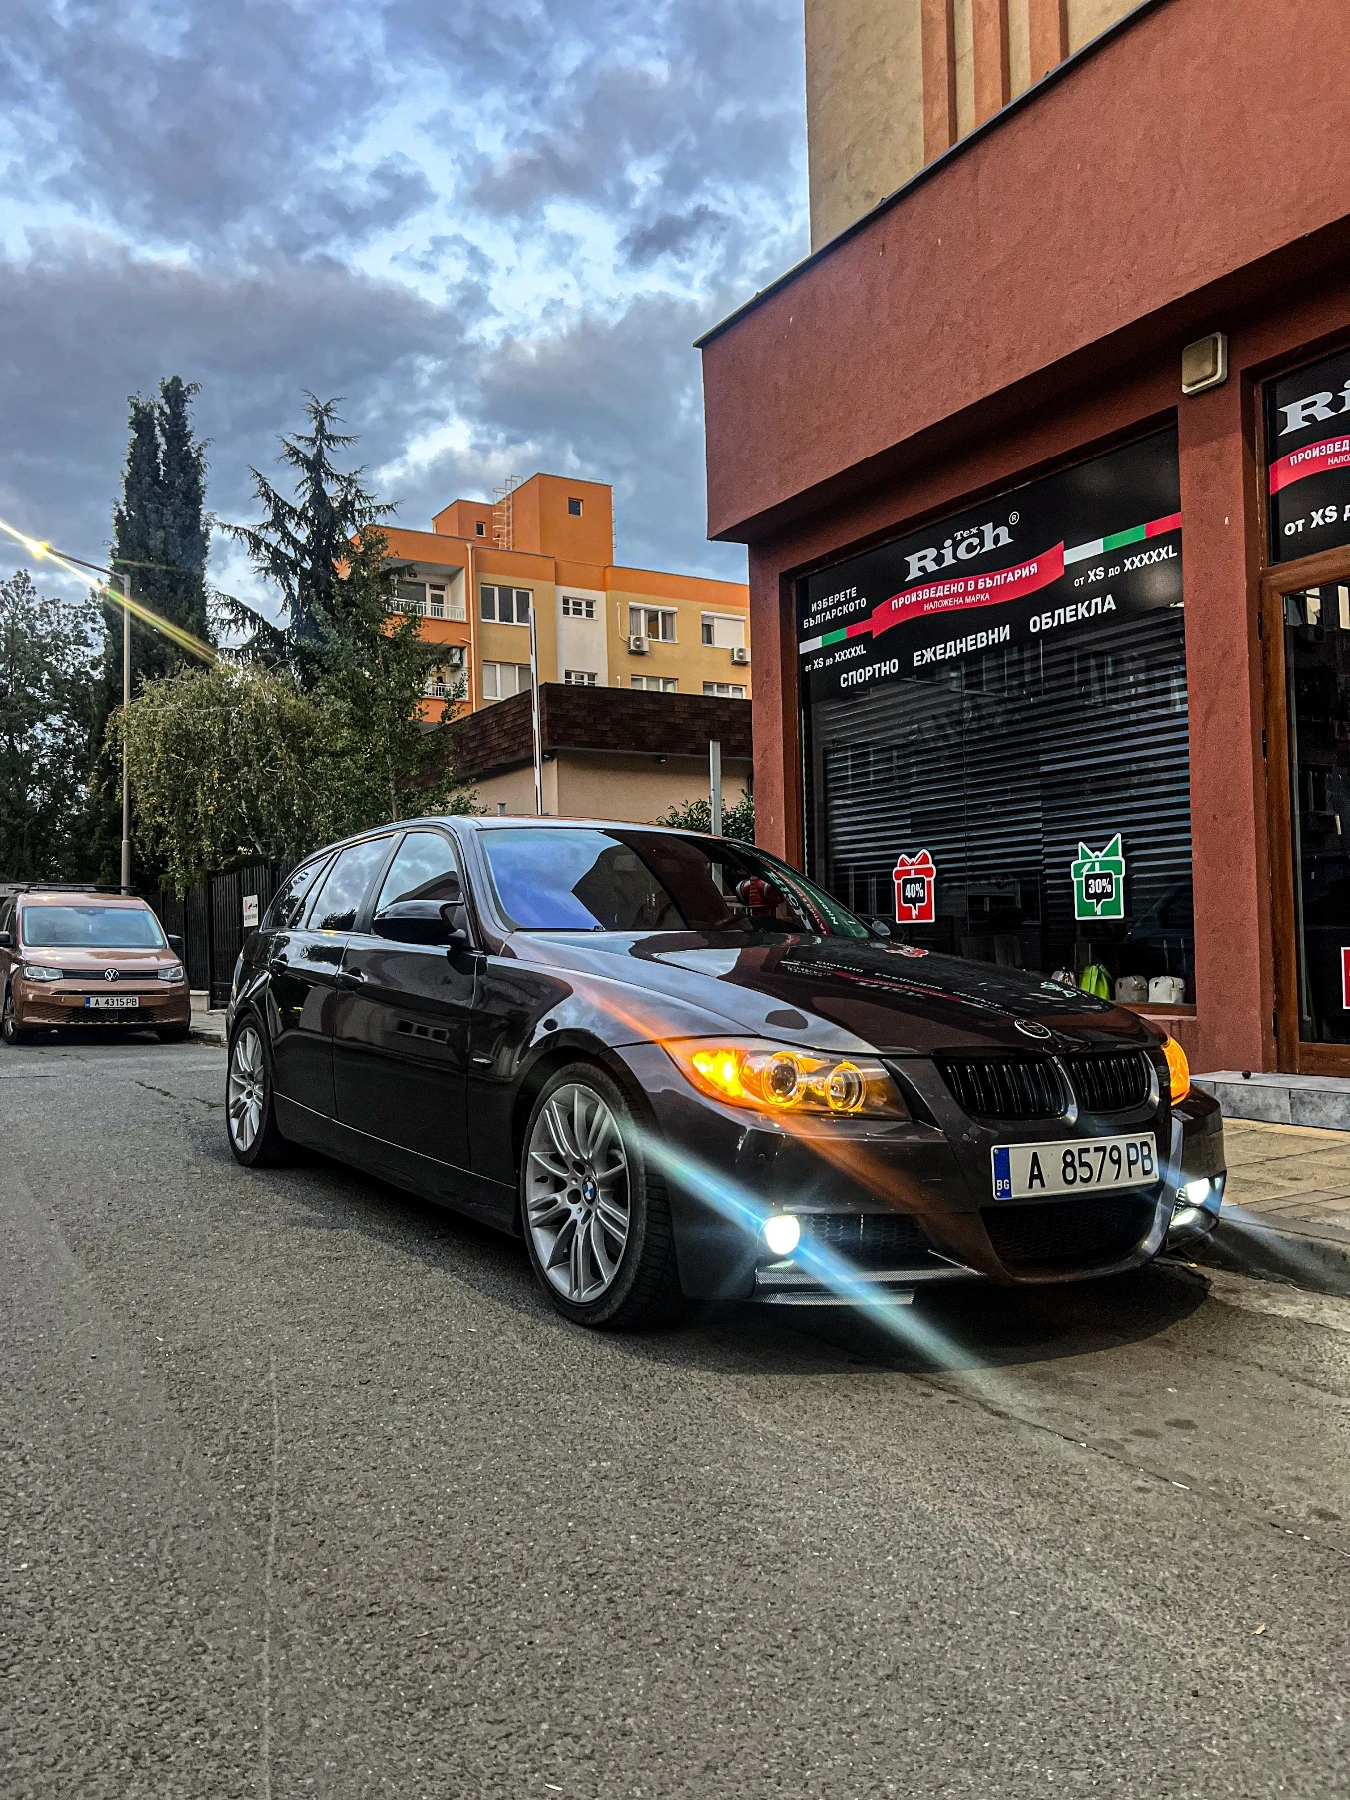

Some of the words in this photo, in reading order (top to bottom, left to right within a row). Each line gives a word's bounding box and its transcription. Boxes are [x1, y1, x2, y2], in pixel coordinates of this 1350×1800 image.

[1327, 453, 1350, 466] НАЛО
[1284, 519, 1305, 535] от
[1310, 505, 1337, 528] XS
[954, 526, 978, 541] Tex
[904, 522, 1014, 581] Rich
[891, 581, 964, 610] ПРОИЗВЕДЕНО
[978, 562, 1038, 587] БЪЛГАРИЯ
[1074, 577, 1084, 587] от
[1087, 567, 1105, 583] XS
[1108, 566, 1120, 577] до
[811, 587, 857, 613] ИЗБЕРЕТЕ
[923, 596, 964, 611] НАЛОЖЕНА
[965, 592, 990, 604] МАРКА
[803, 597, 867, 629] БЪЛГАРСКОТО
[840, 658, 899, 688] СПОРТНО
[913, 624, 1011, 667] ЕЖЕДНЕВНИ
[1029, 594, 1117, 633] ОБЛЕКЛА
[813, 657, 824, 670] XS
[905, 882, 924, 898] 40%
[1088, 877, 1111, 894] 30%
[996, 1179, 1010, 1190] BG
